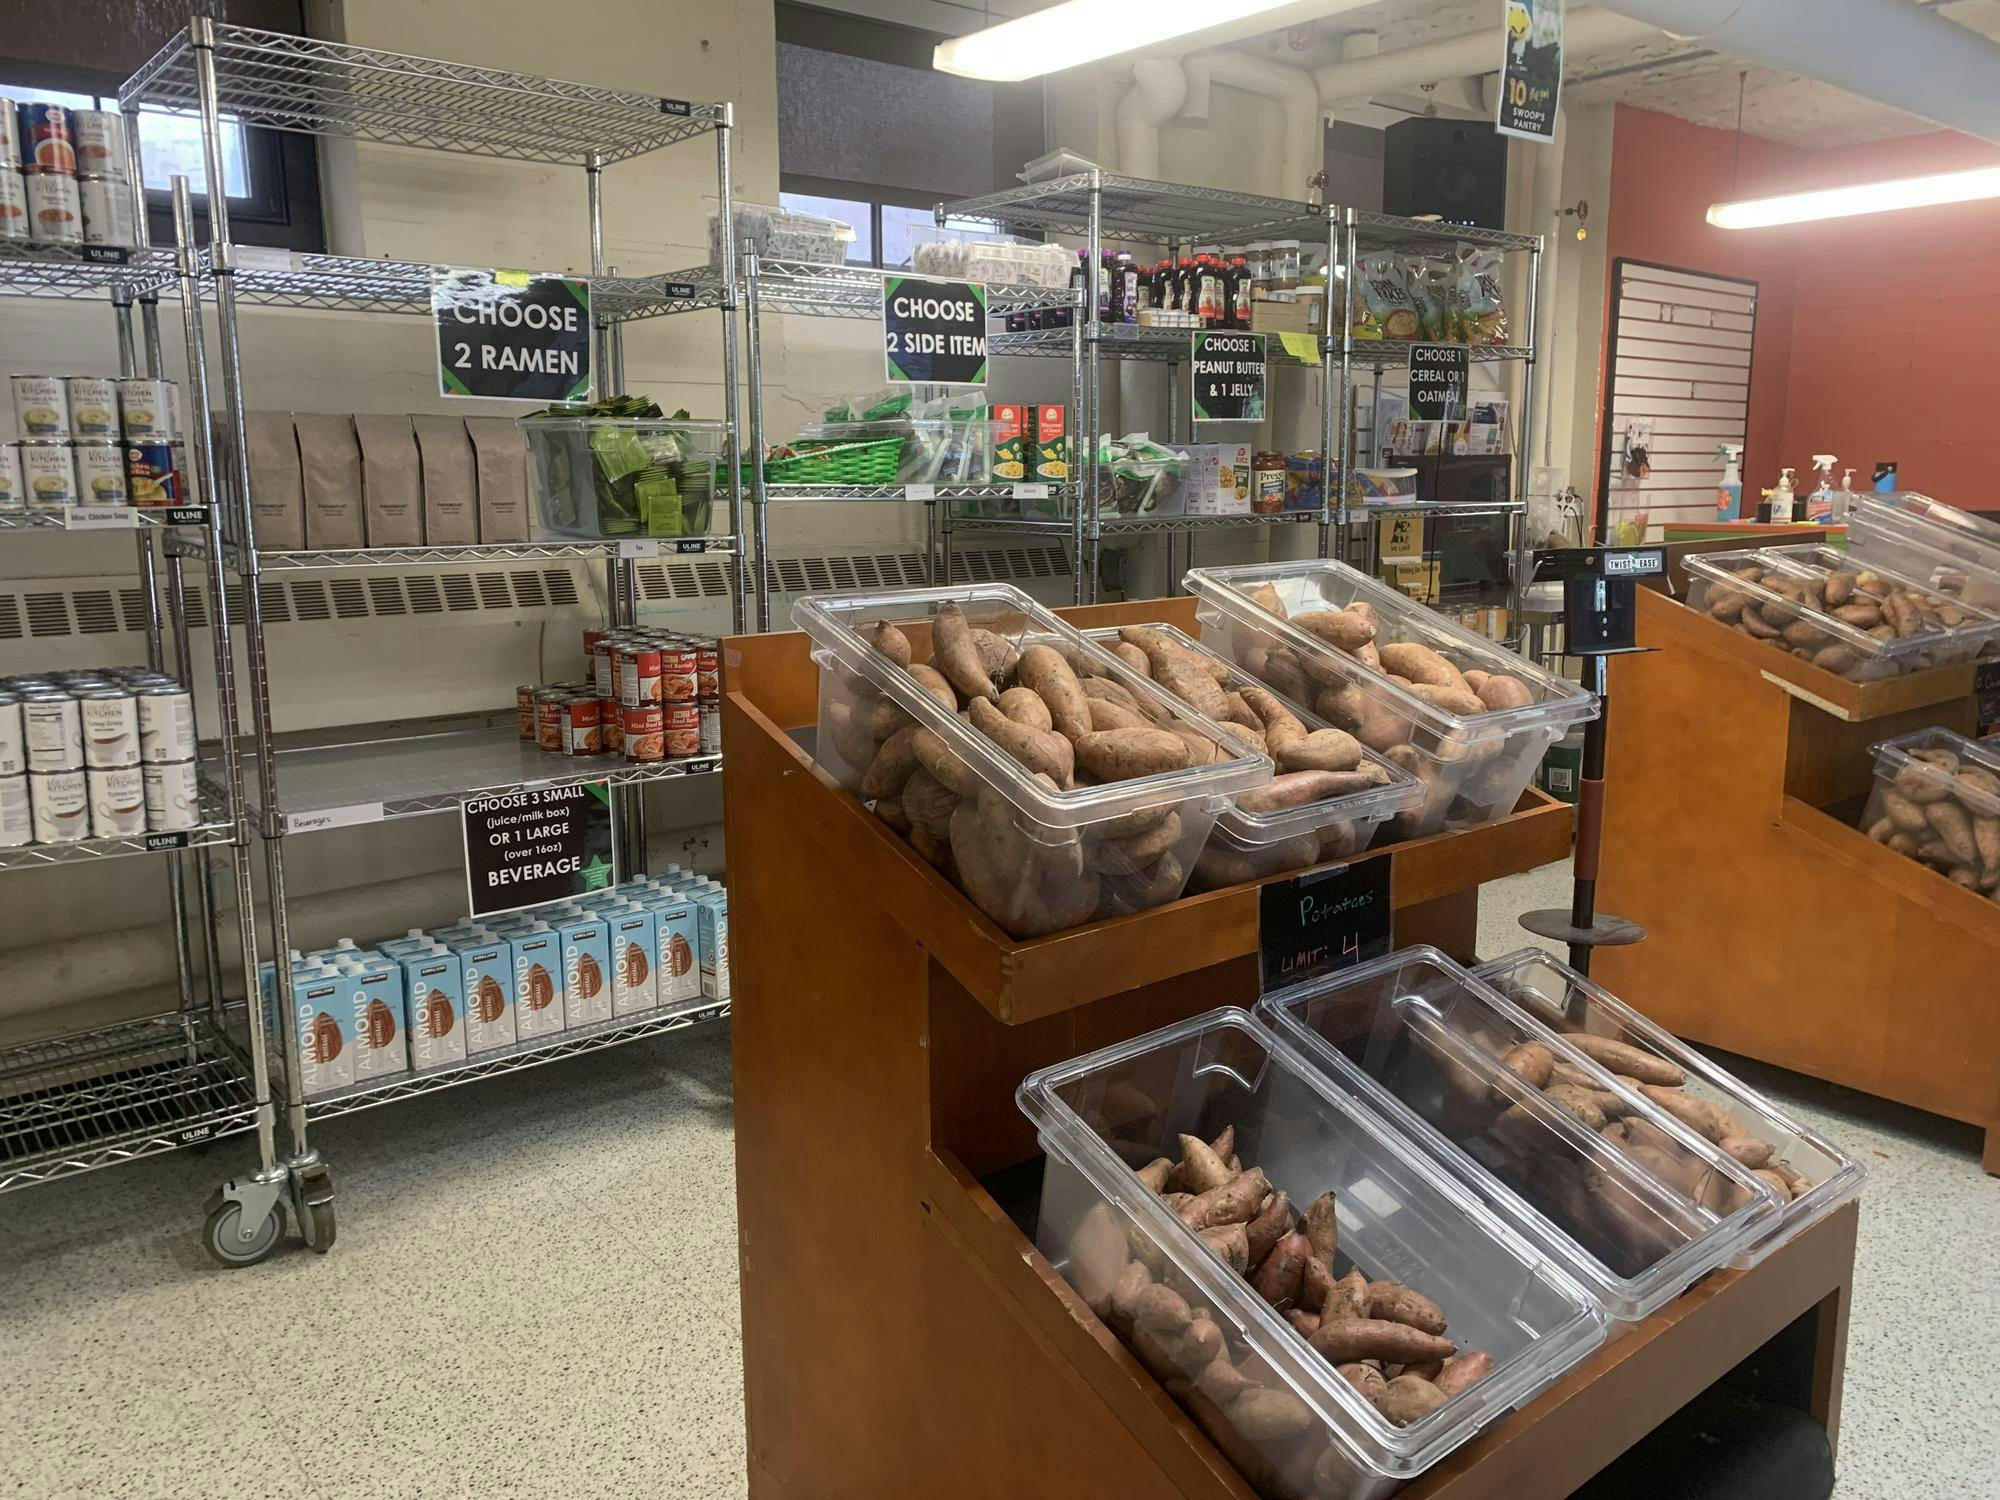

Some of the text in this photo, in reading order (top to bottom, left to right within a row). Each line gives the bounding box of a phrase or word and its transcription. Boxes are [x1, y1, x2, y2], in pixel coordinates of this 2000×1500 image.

[1510, 78, 1527, 106] 10
[1513, 107, 1545, 122] SWOOP'S
[1513, 118, 1542, 132] PANTRY
[90, 249, 121, 258] ULINE
[671, 286, 691, 295] ULINE
[454, 299, 578, 332] CHOOSE
[893, 297, 975, 322] CHOOSE
[886, 333, 986, 357] 2 SIDE ITEM
[1204, 338, 1256, 352] CHOOSE 1
[1415, 348, 1456, 362] CHOOSE
[454, 342, 578, 375] 2 RAMEN
[1194, 361, 1265, 375] PEANUT BUTTER
[1410, 369, 1446, 382] CEREAL
[1447, 371, 1459, 383] OR
[1209, 383, 1253, 397] & 1 JELLY
[1417, 390, 1459, 403] OATMEAL
[1260, 471, 1284, 481] Prego
[173, 511, 202, 520] ULINE
[1610, 558, 1656, 569] TWIST EASE
[691, 763, 710, 771] ULINE
[467, 786, 585, 815] CHOOSE 3 SMALL
[293, 816, 332, 828] Beverages
[486, 806, 570, 830] (juice/milk box)
[149, 836, 177, 847] ULINE
[489, 822, 570, 846] OR 1 LARGE
[504, 842, 562, 862] (over 16oz)
[488, 856, 581, 888] BEVERAGE
[1300, 889, 1375, 927] Potatoes
[717, 921, 730, 990] ALMOND
[1342, 931, 1359, 963] 4
[615, 935, 629, 1007] ALMOND
[659, 926, 673, 996] ALMOND
[517, 956, 533, 1030] ALMOND
[566, 946, 582, 1018] ALMOND
[466, 968, 483, 1043] ALMOND
[353, 990, 371, 1070] ALMOND
[414, 981, 432, 1059] ALMOND
[300, 1004, 318, 1085] ALMOND
[182, 1126, 210, 1140] ULINE
